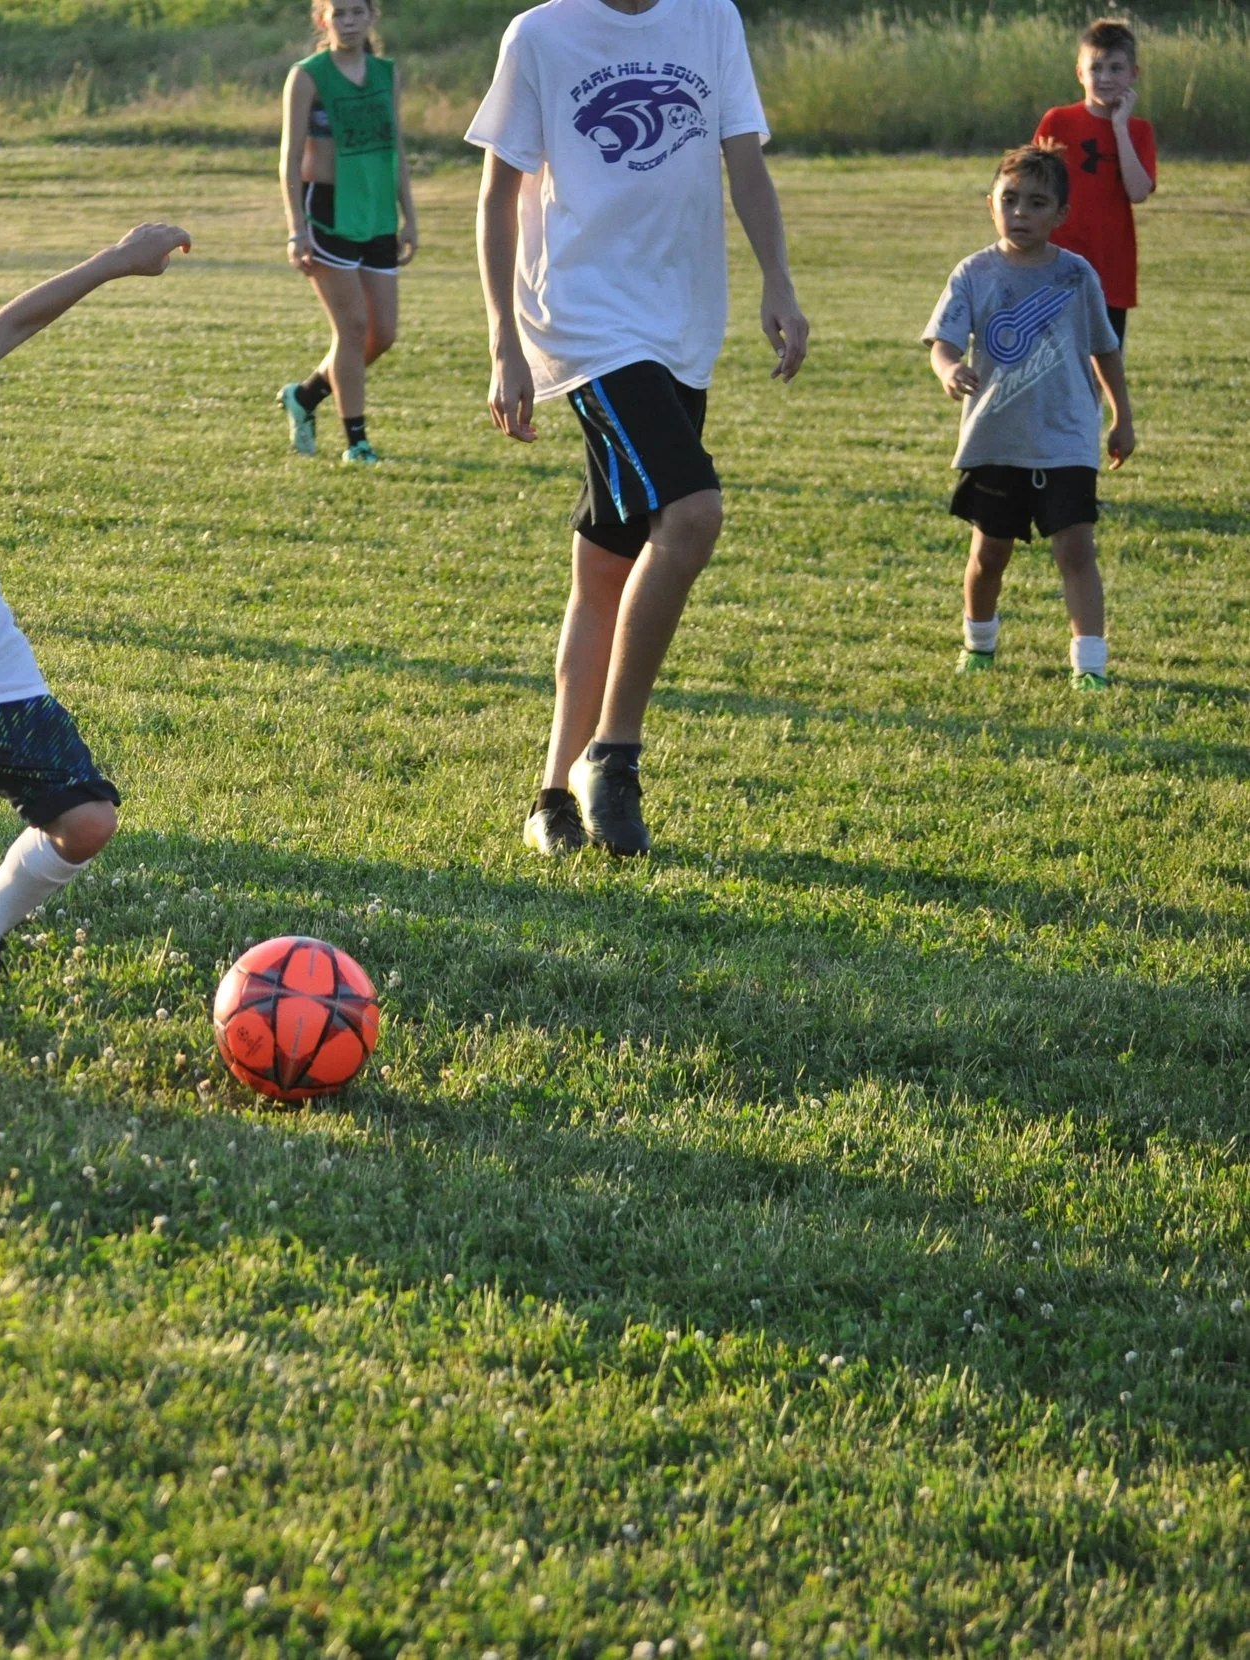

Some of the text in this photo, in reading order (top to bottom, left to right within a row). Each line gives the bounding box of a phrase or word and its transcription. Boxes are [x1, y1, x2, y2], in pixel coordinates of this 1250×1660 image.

[570, 61, 712, 103] PARK HILL SOUTH
[627, 149, 668, 171] SOCCER
